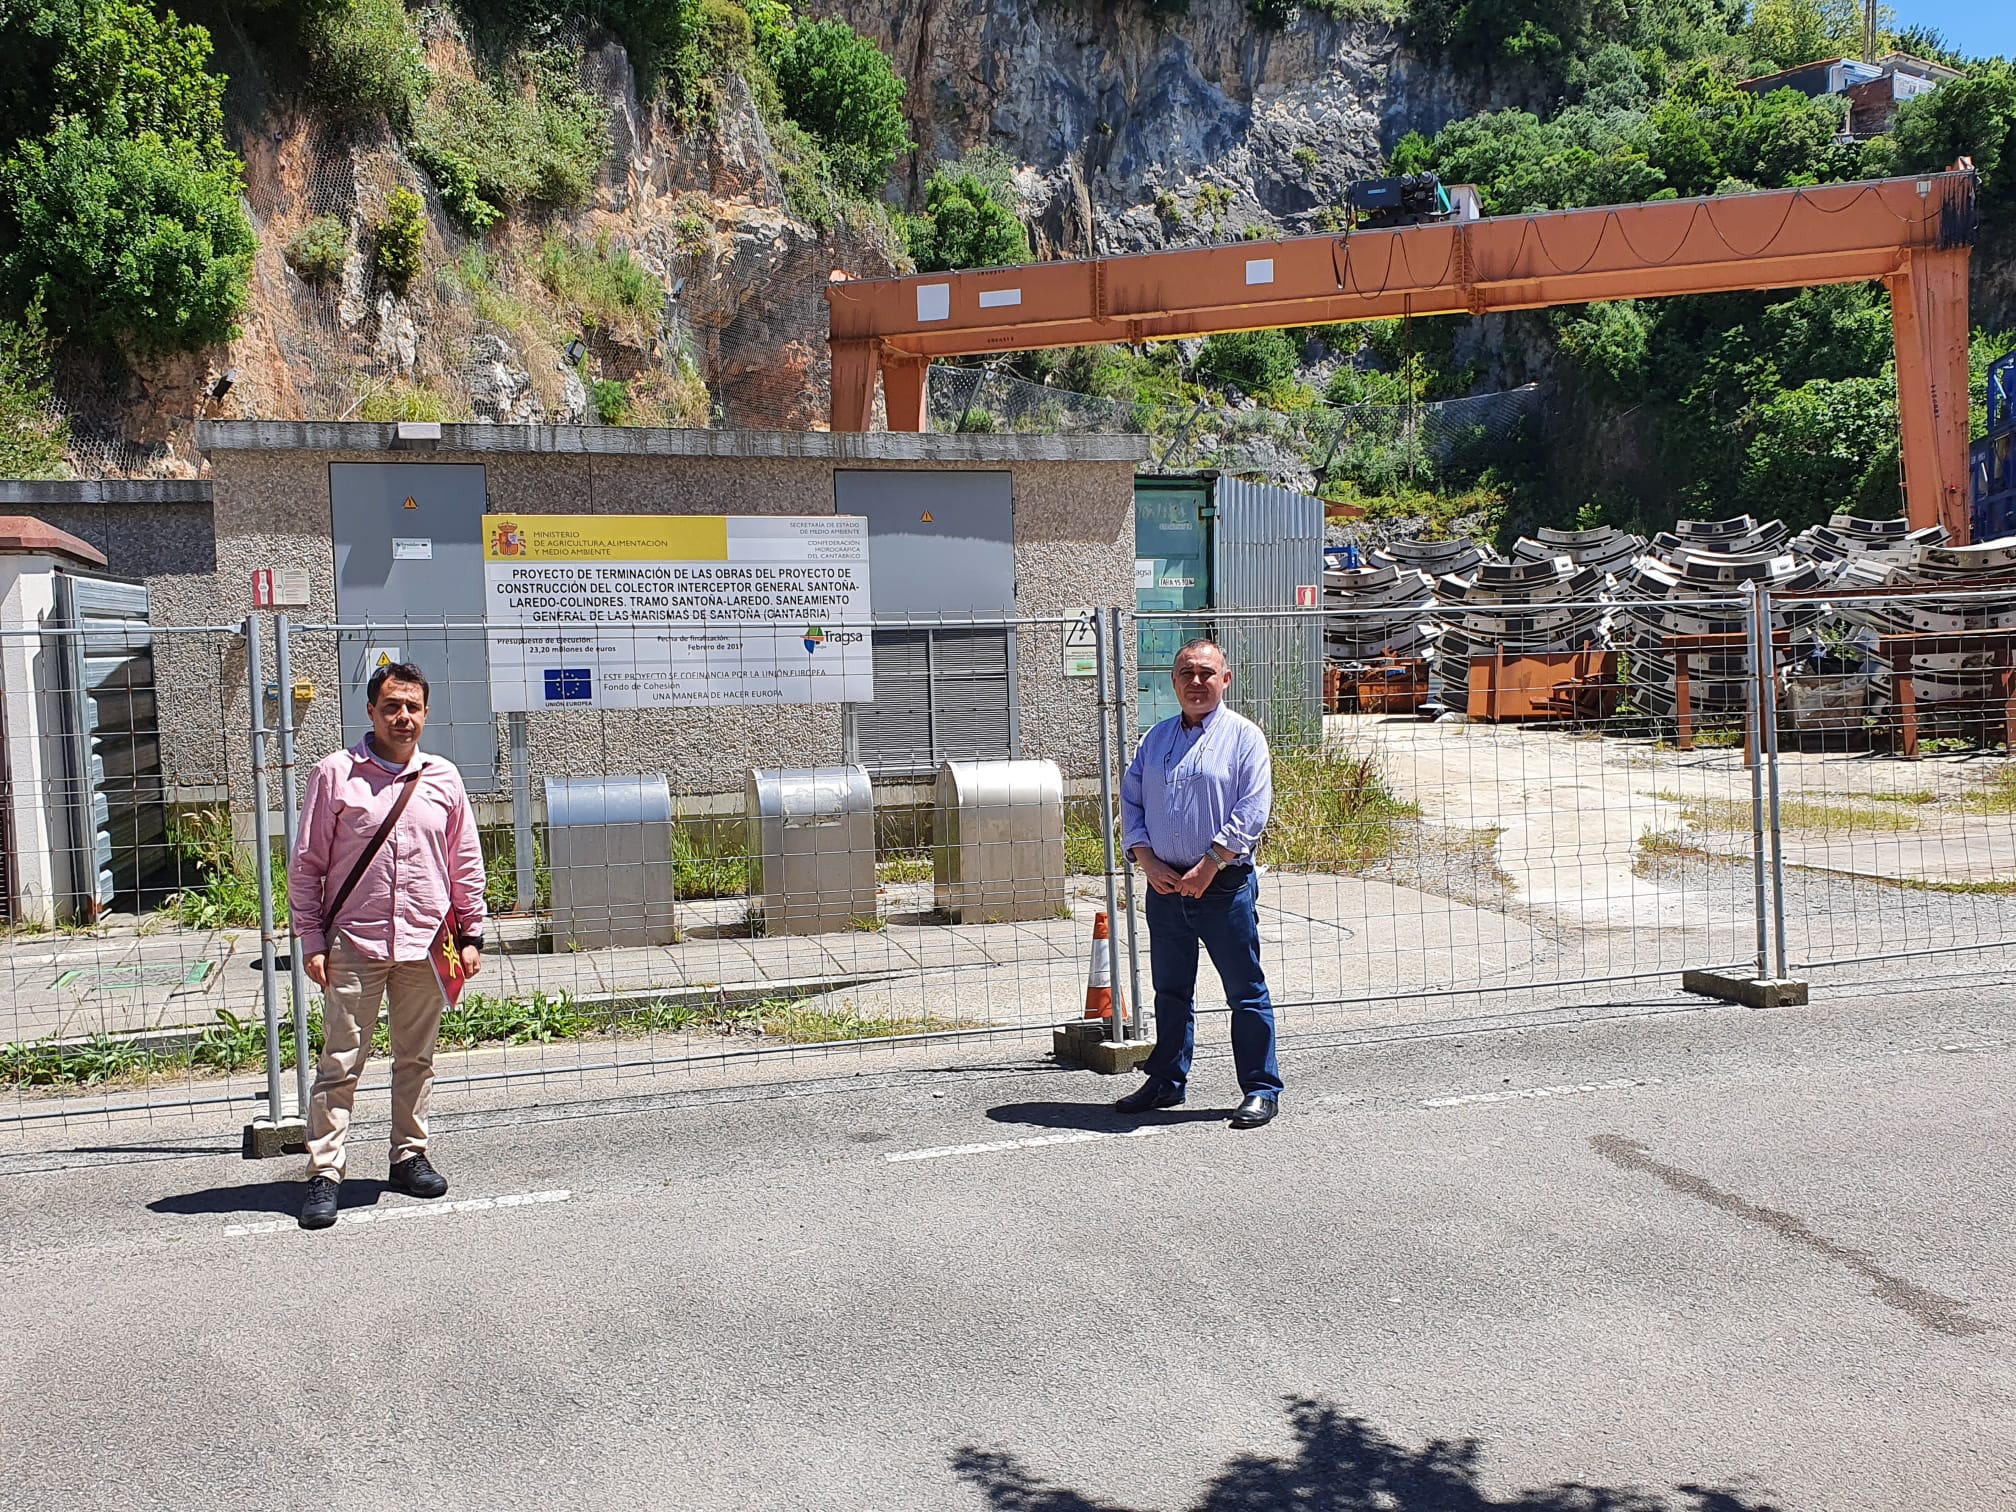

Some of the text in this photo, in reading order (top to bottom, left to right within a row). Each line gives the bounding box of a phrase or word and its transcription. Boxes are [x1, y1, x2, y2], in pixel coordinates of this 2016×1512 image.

[512, 566, 851, 580] PROYECTO DE TERMINACIÓN DE LAS OBRAS DEL PROYECTO DE
[497, 579, 859, 593] CONSTRUCCIÓN DEL COLECTOR INTERCEPTOR GENERAL SANTOÑA-
[510, 594, 849, 608] LAREDO-COLINDRES. TRAMO SANTOÑA-LAREDO. SANEAMIENTO
[533, 608, 830, 621] GENERAL DE LAS MARISMAS DE SANTOÑA (CANTABRIA)
[824, 630, 863, 645] Tragsa
[530, 646, 550, 654] 23,20
[750, 670, 759, 678] LA
[631, 682, 641, 690] de
[644, 682, 680, 690] Cohesión
[652, 690, 783, 700] UNA MANERA DE HACER EUROPA
